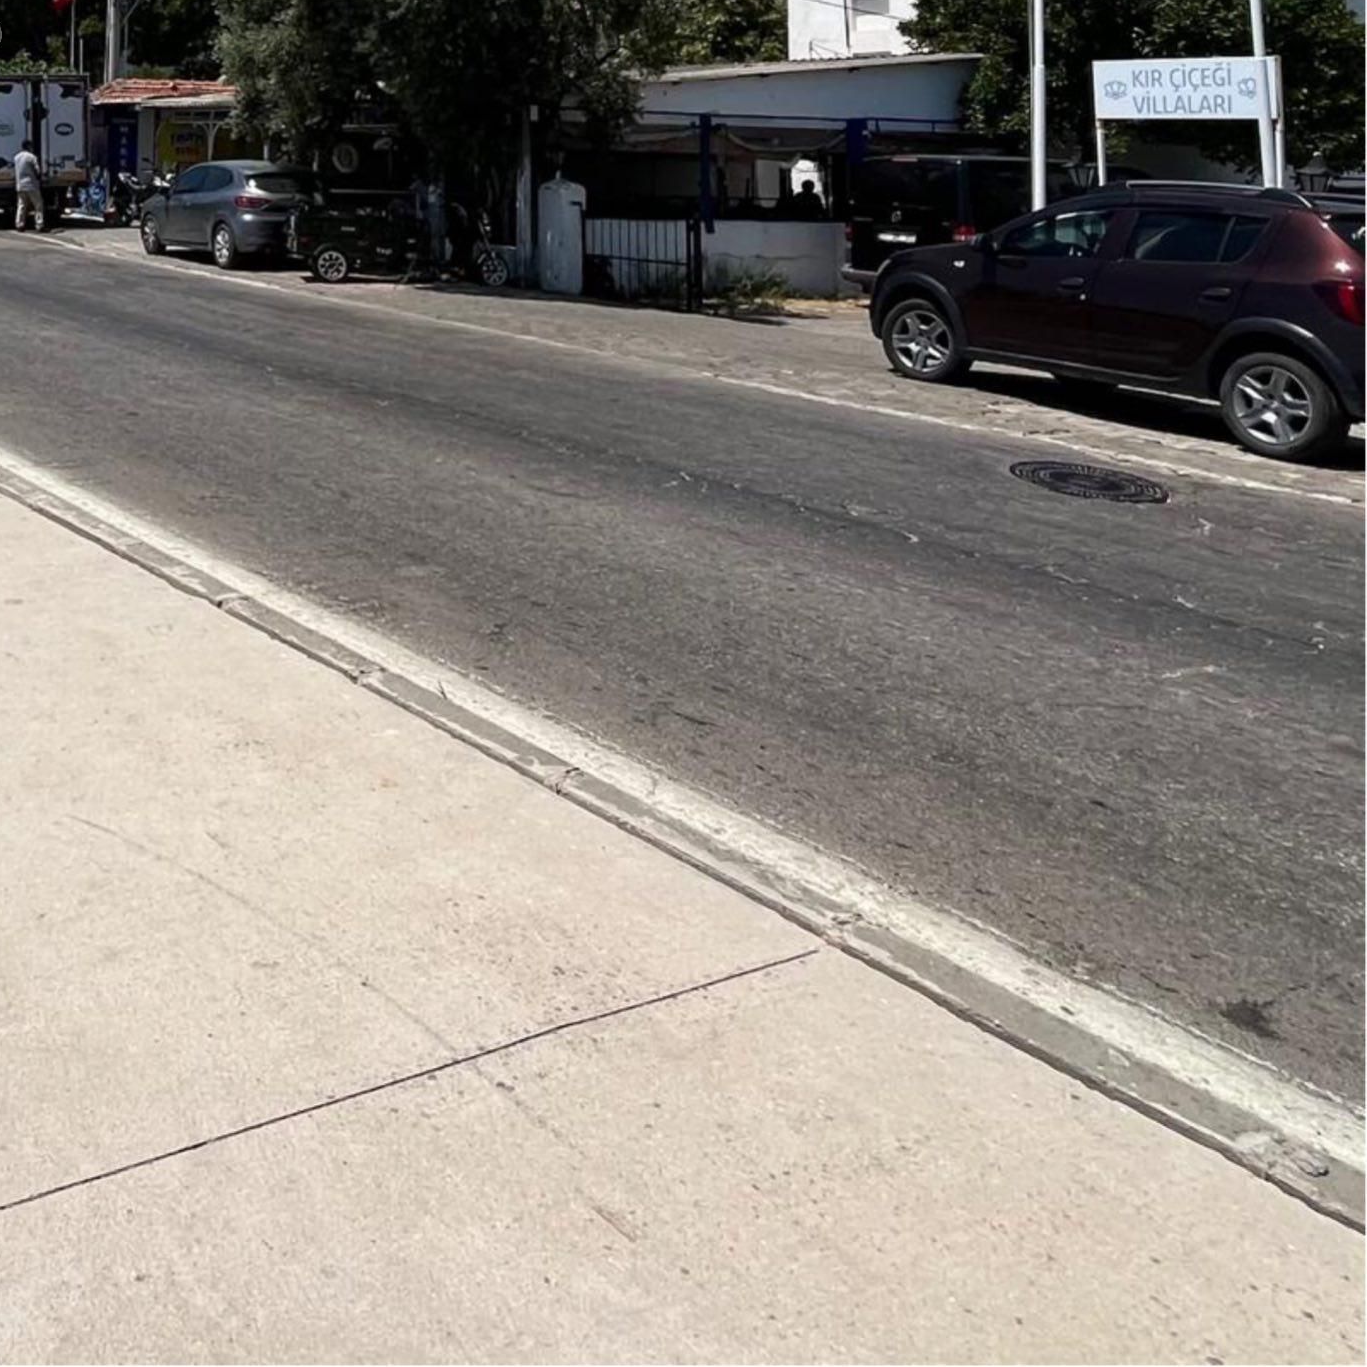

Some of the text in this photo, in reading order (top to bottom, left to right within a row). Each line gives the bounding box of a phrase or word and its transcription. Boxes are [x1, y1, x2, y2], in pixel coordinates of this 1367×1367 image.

[1132, 62, 1232, 92] KIR ÇİÇEĞİ
[1133, 91, 1232, 114] VİLLALARI
